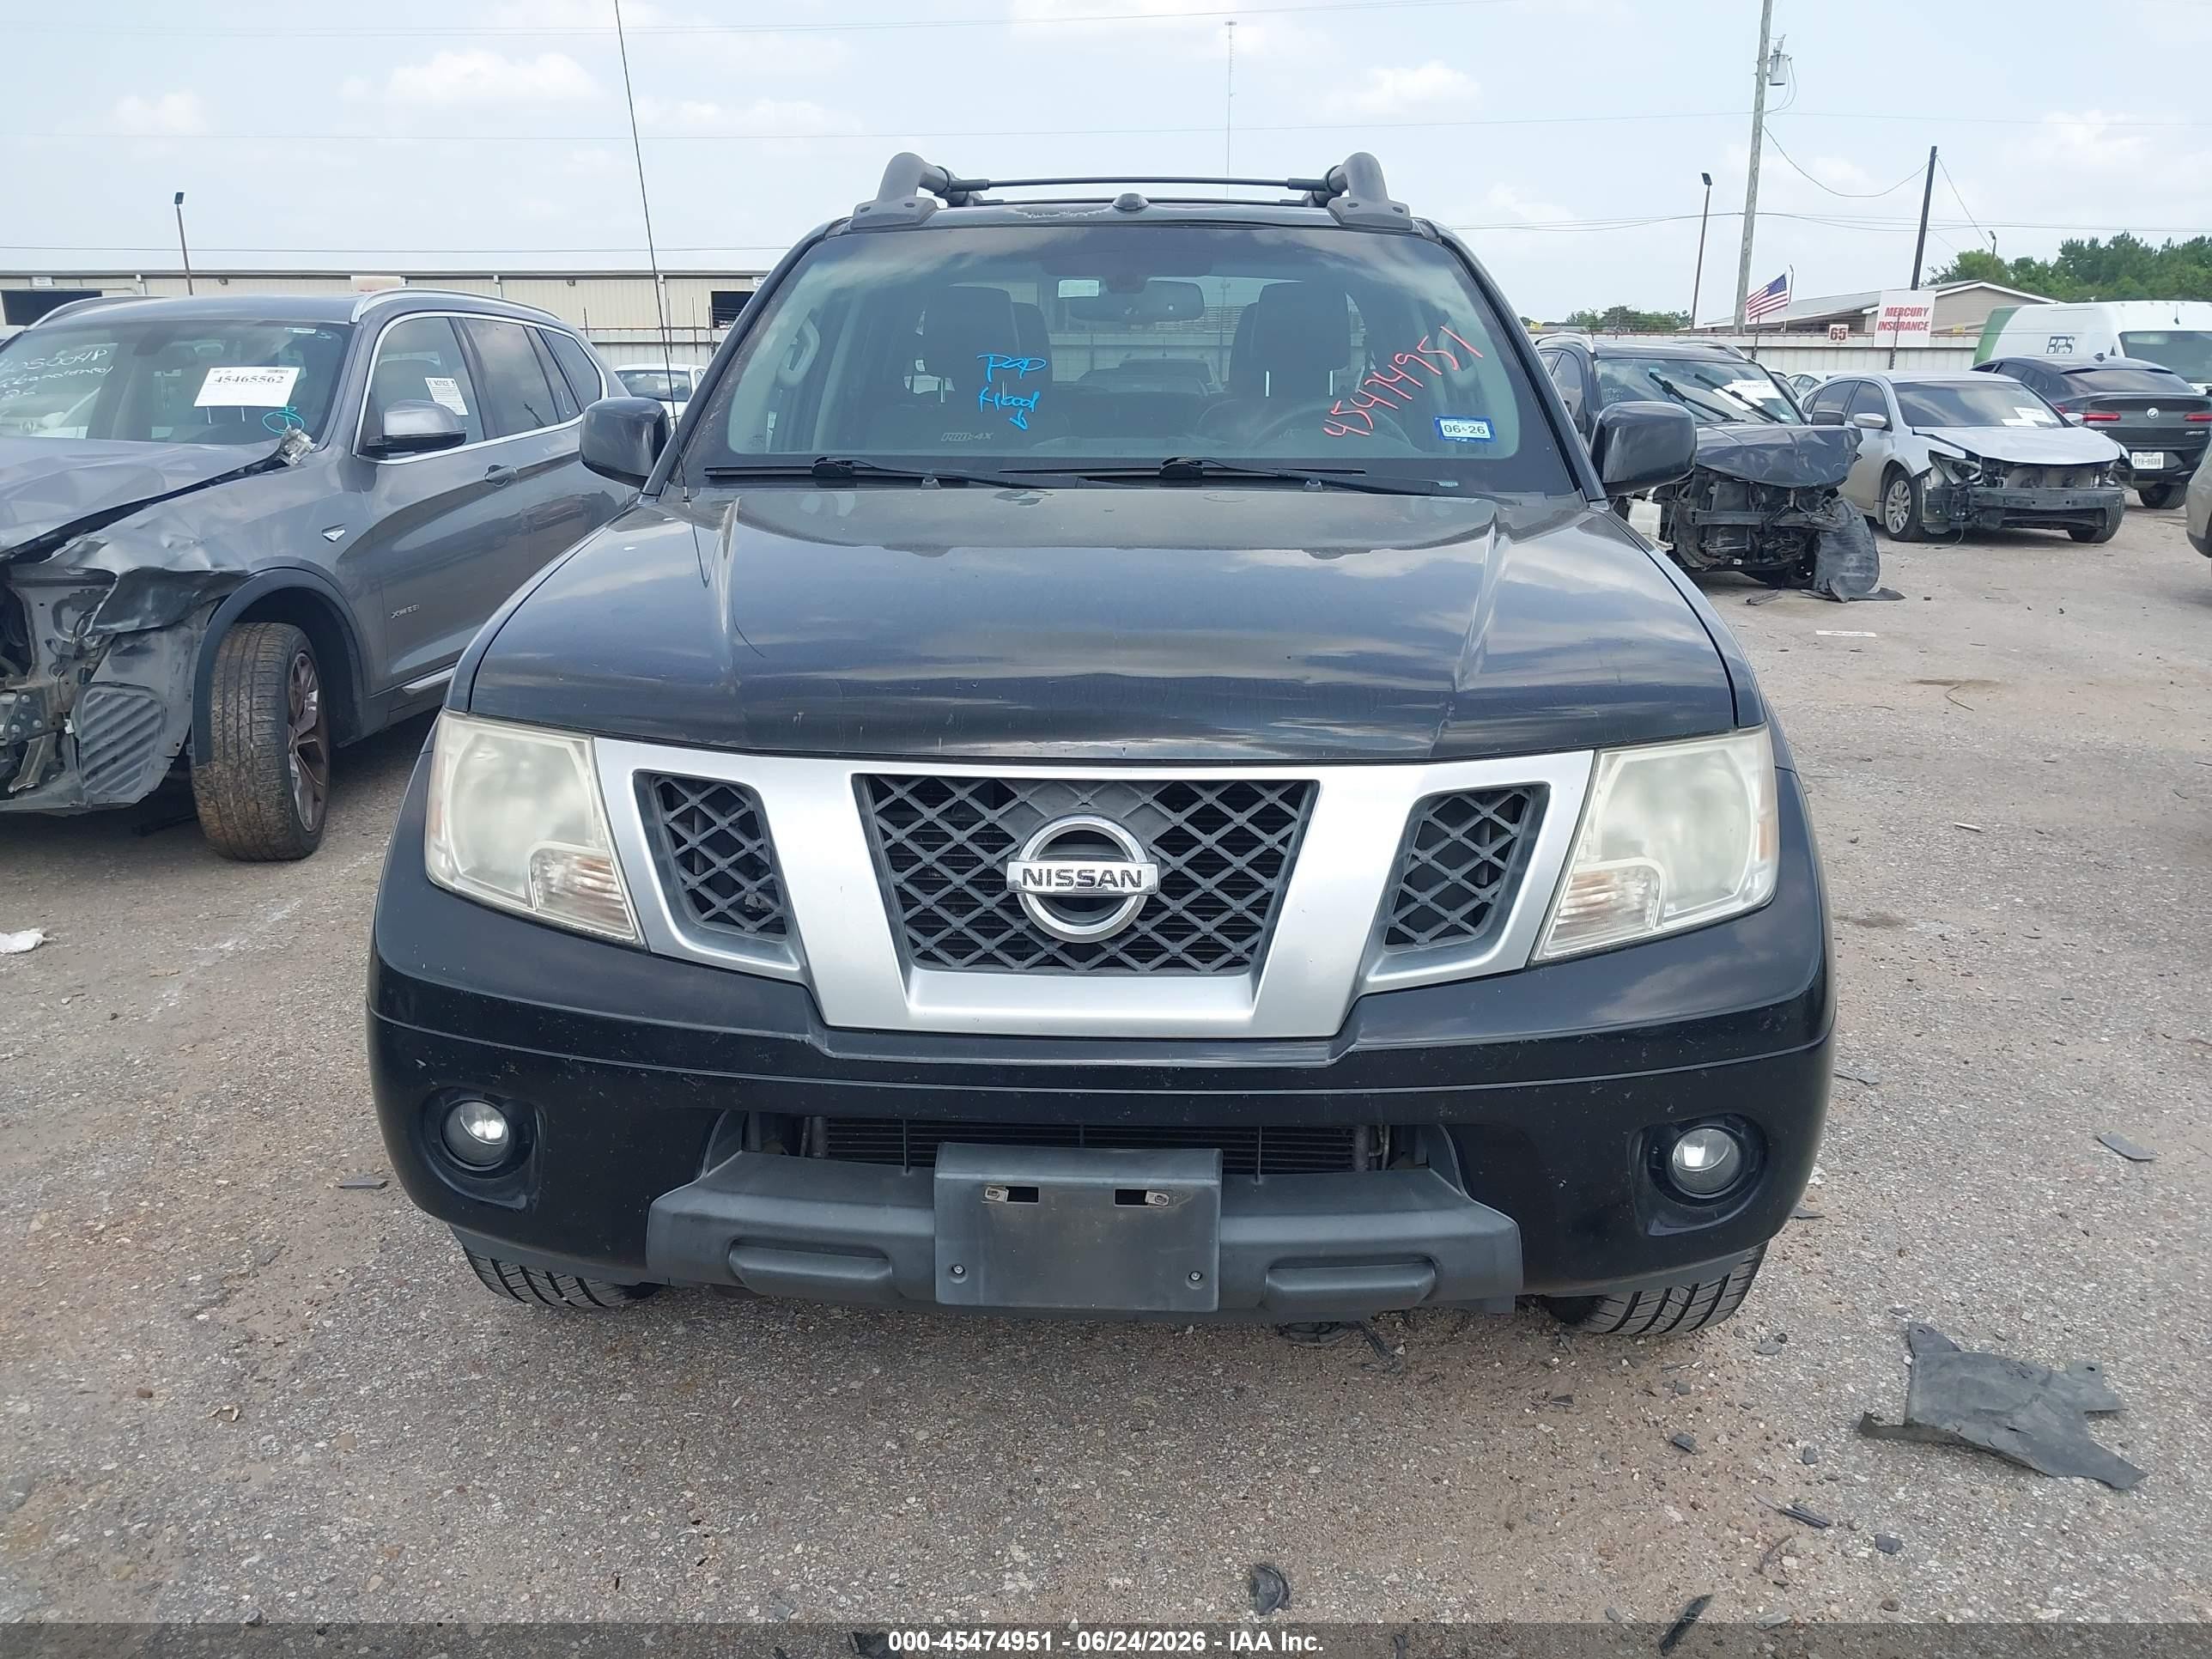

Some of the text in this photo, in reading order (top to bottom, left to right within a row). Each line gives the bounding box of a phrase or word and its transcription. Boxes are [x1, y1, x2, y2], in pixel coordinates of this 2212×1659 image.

[1884, 307, 1930, 318] MERCURY
[1877, 320, 1930, 331] INSURANCE
[1829, 327, 1847, 341] 65
[214, 375, 285, 384] 45465562
[1322, 325, 1484, 437] 45474951
[1022, 868, 1142, 888] NISSAN
